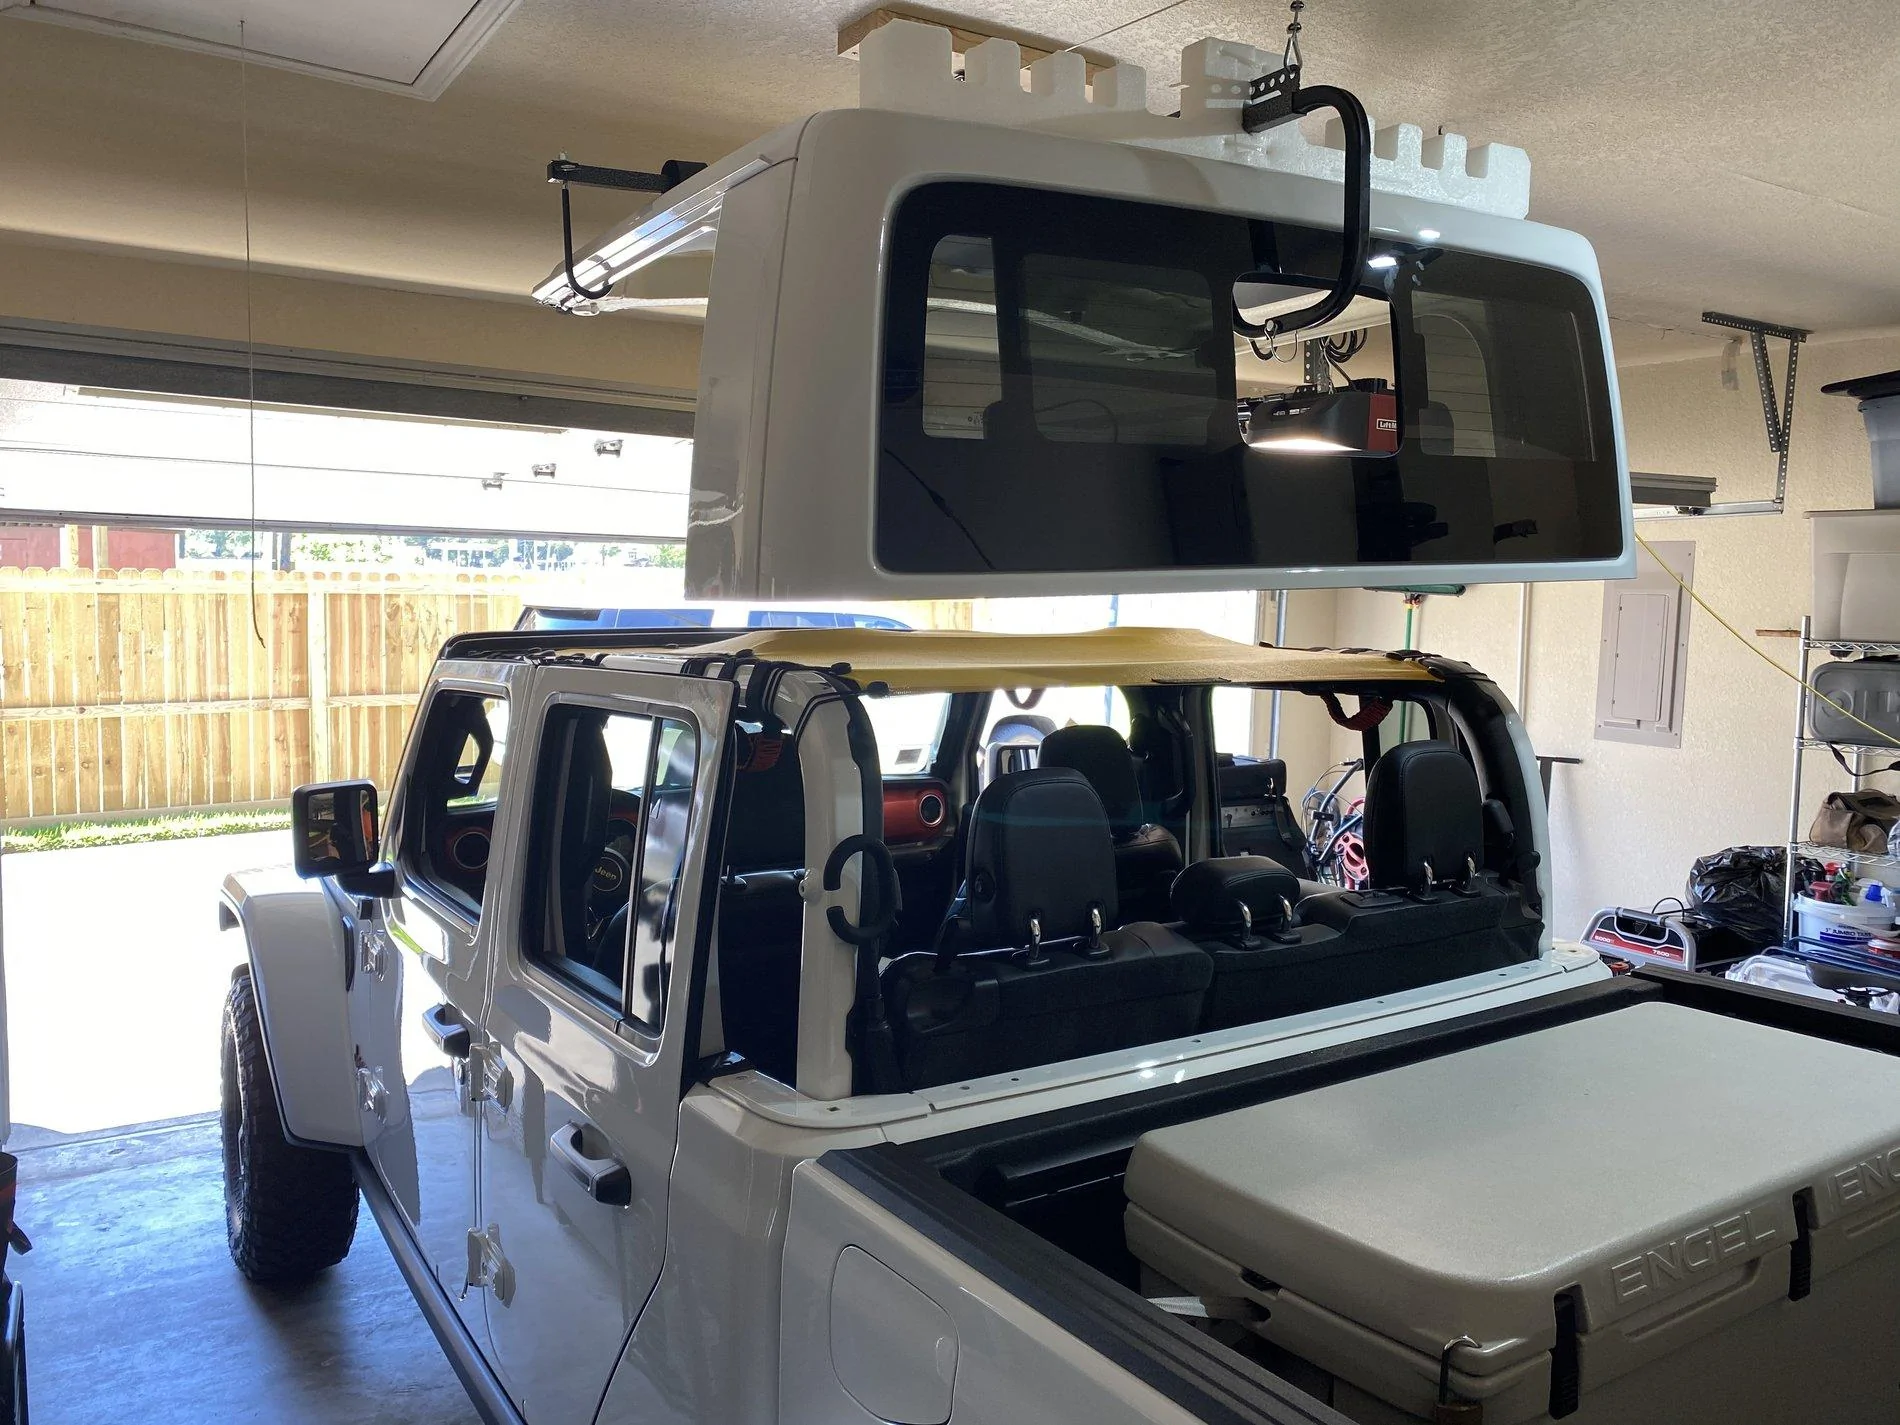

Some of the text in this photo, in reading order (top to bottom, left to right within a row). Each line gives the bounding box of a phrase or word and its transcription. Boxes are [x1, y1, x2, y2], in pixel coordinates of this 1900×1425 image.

[1380, 421, 1397, 429] LiftM
[1832, 929, 1856, 937] JUMBO
[1834, 1147, 1900, 1202] ENG
[1611, 1210, 1776, 1300] ENGEL
